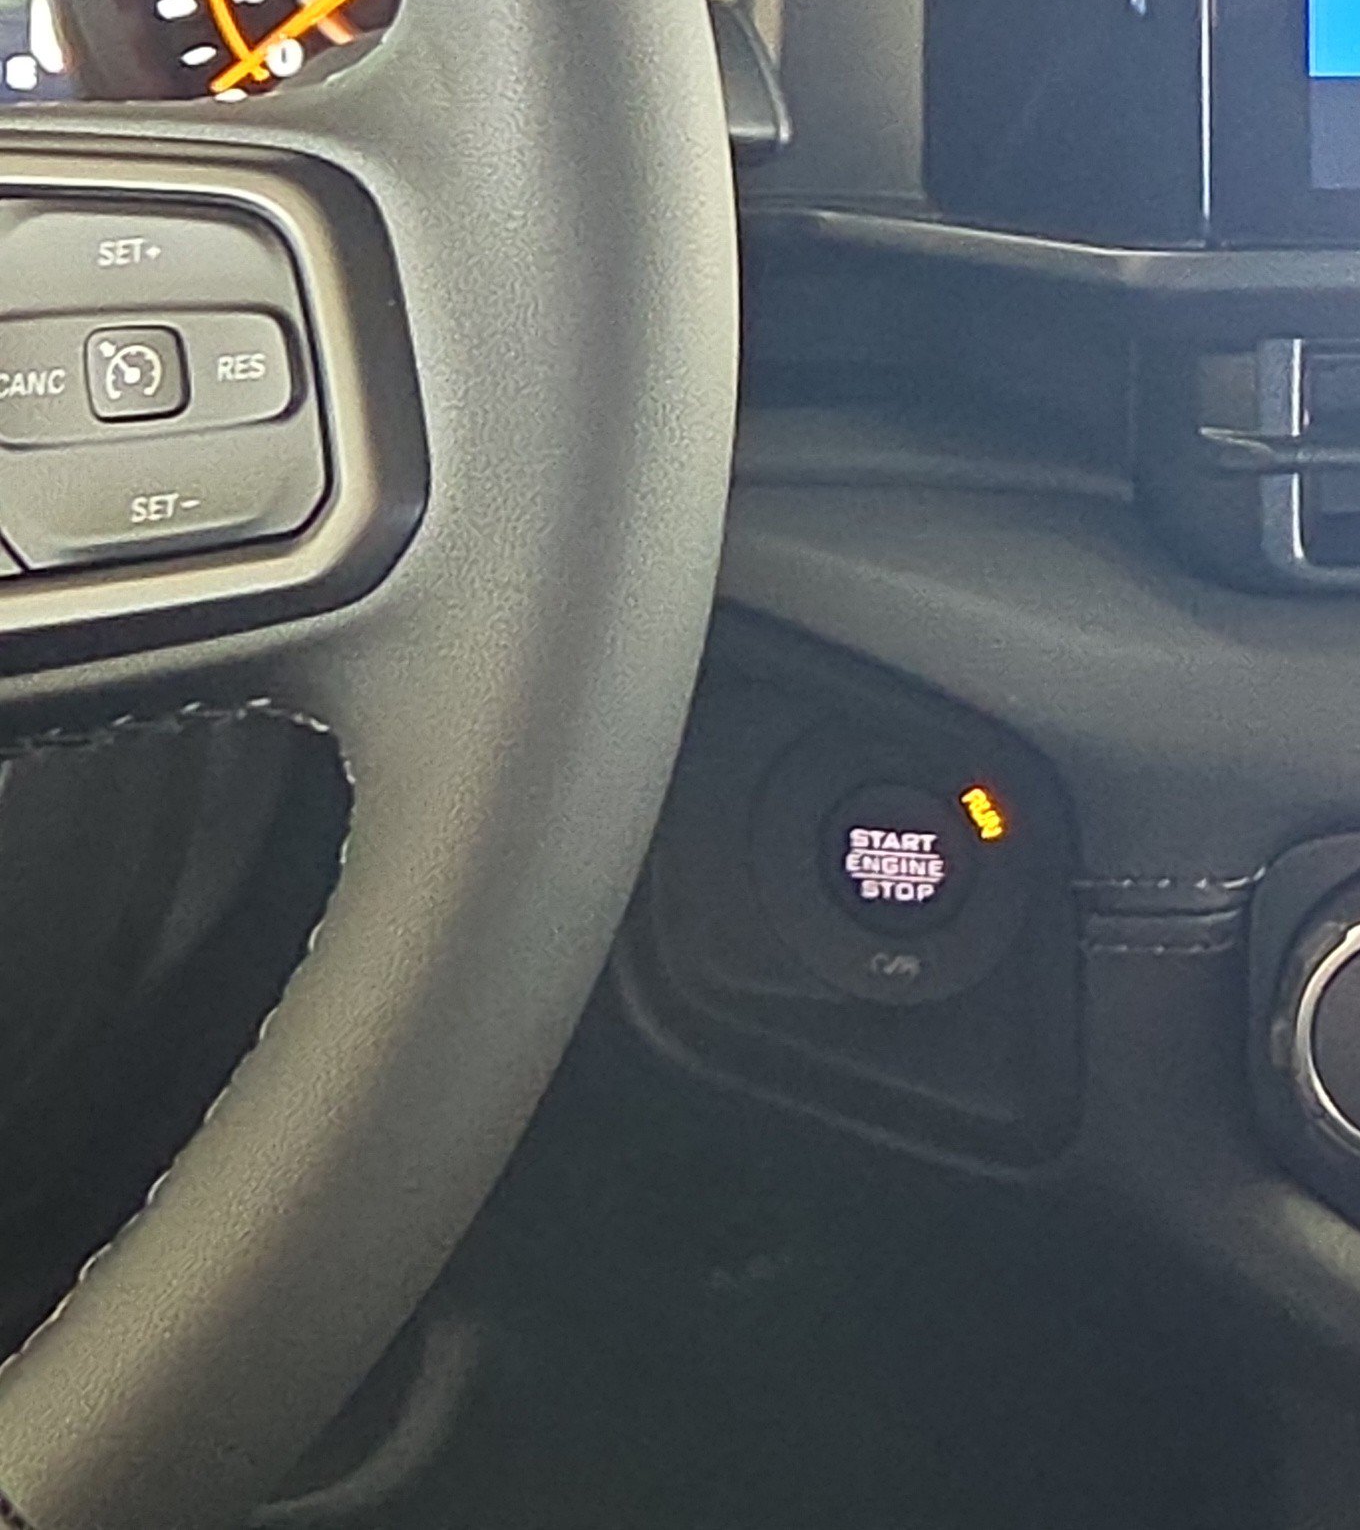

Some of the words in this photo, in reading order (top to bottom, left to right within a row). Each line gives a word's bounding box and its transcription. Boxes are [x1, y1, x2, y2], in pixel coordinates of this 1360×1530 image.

[99, 238, 161, 266] SET+
[216, 353, 266, 381] RES
[850, 829, 937, 851] START
[846, 854, 944, 876] ENGINE
[861, 880, 935, 901] STOP
